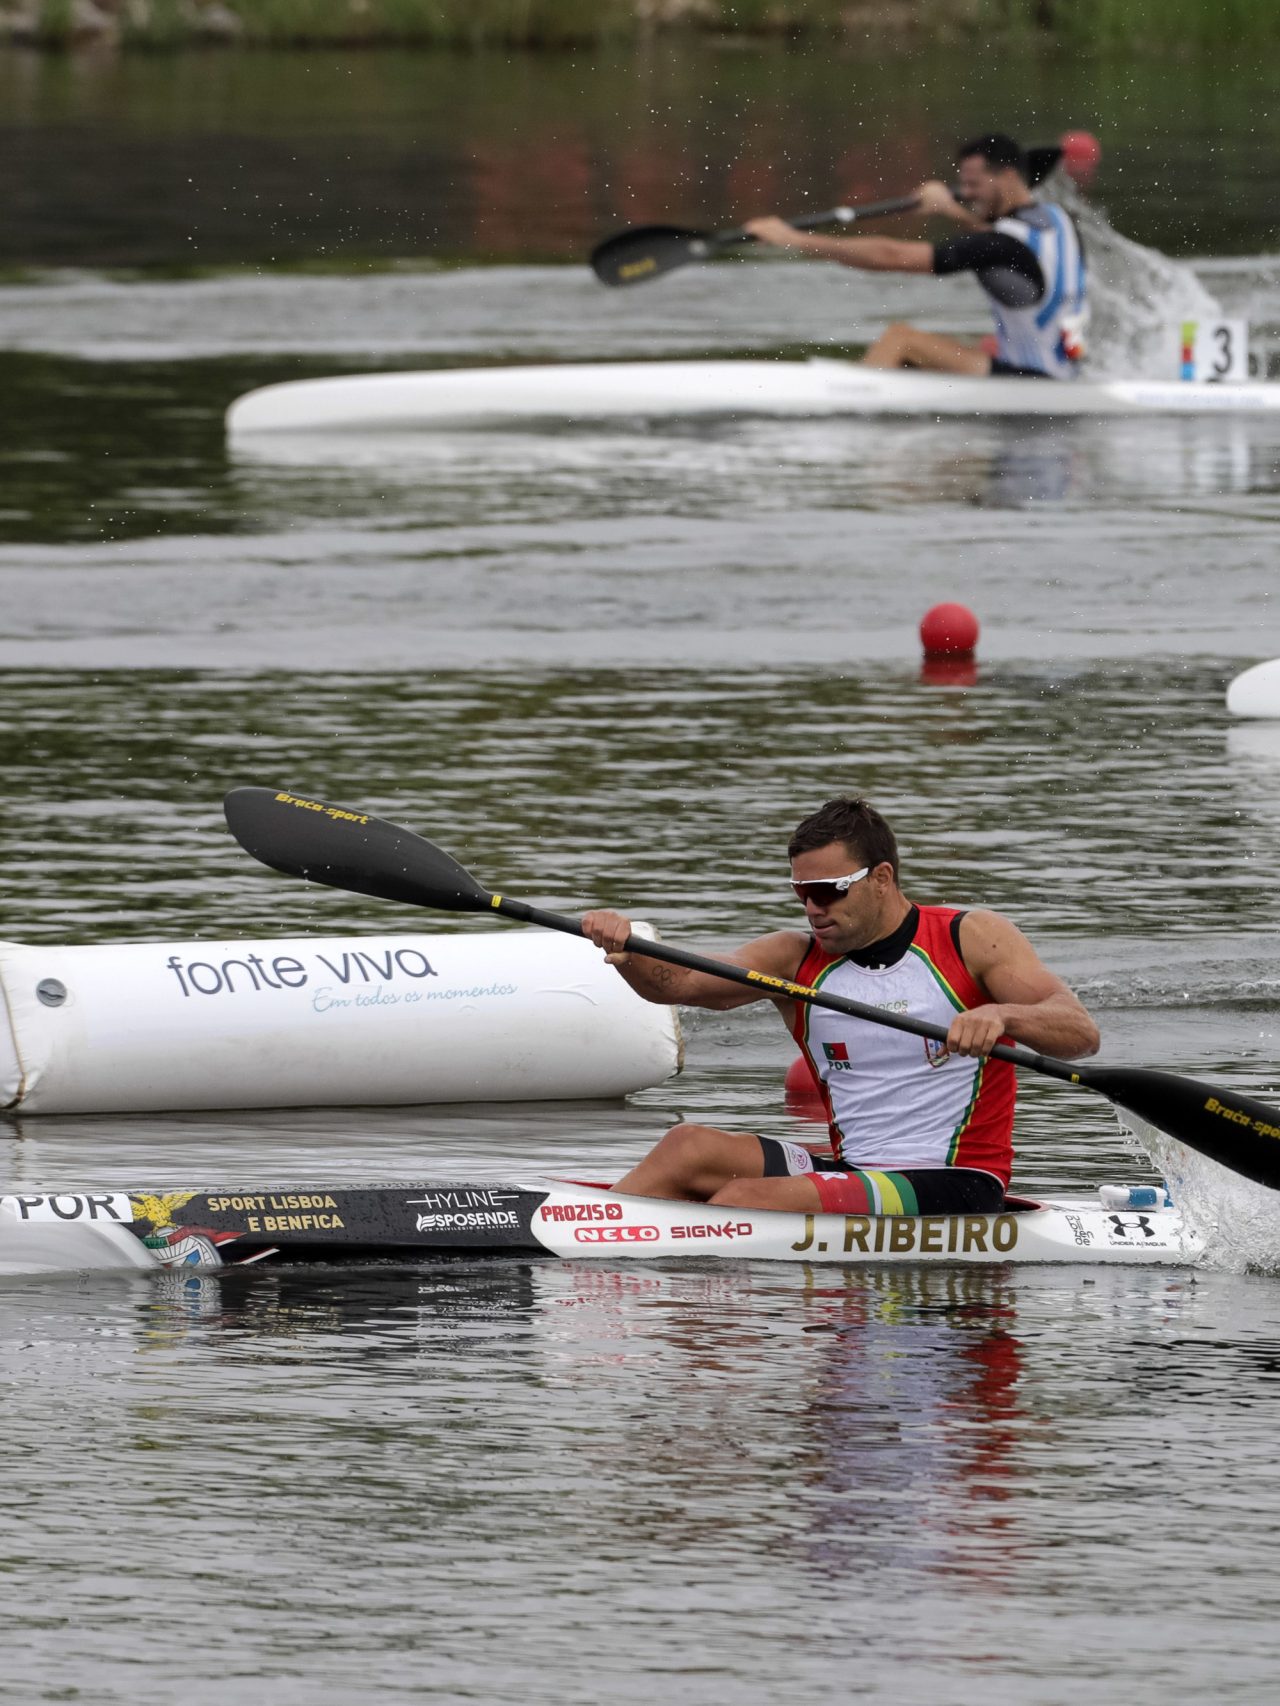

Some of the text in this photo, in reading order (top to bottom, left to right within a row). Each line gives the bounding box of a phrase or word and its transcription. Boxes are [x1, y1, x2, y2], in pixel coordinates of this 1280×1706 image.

[1213, 327, 1232, 373] 3
[167, 949, 438, 997] fonte viva
[312, 983, 518, 1013] Em todos os momentos
[828, 1061, 853, 1071] POR
[16, 1195, 122, 1220] POR
[207, 1194, 338, 1212] SPORT LISBOA
[406, 1190, 519, 1209] HYLINE
[248, 1214, 345, 1232] E BENFICA
[416, 1211, 519, 1232] ESPOSENDE
[540, 1204, 605, 1222] PROZIS
[576, 1227, 658, 1242] NELO
[791, 1214, 1018, 1253] J. RIBEIRO
